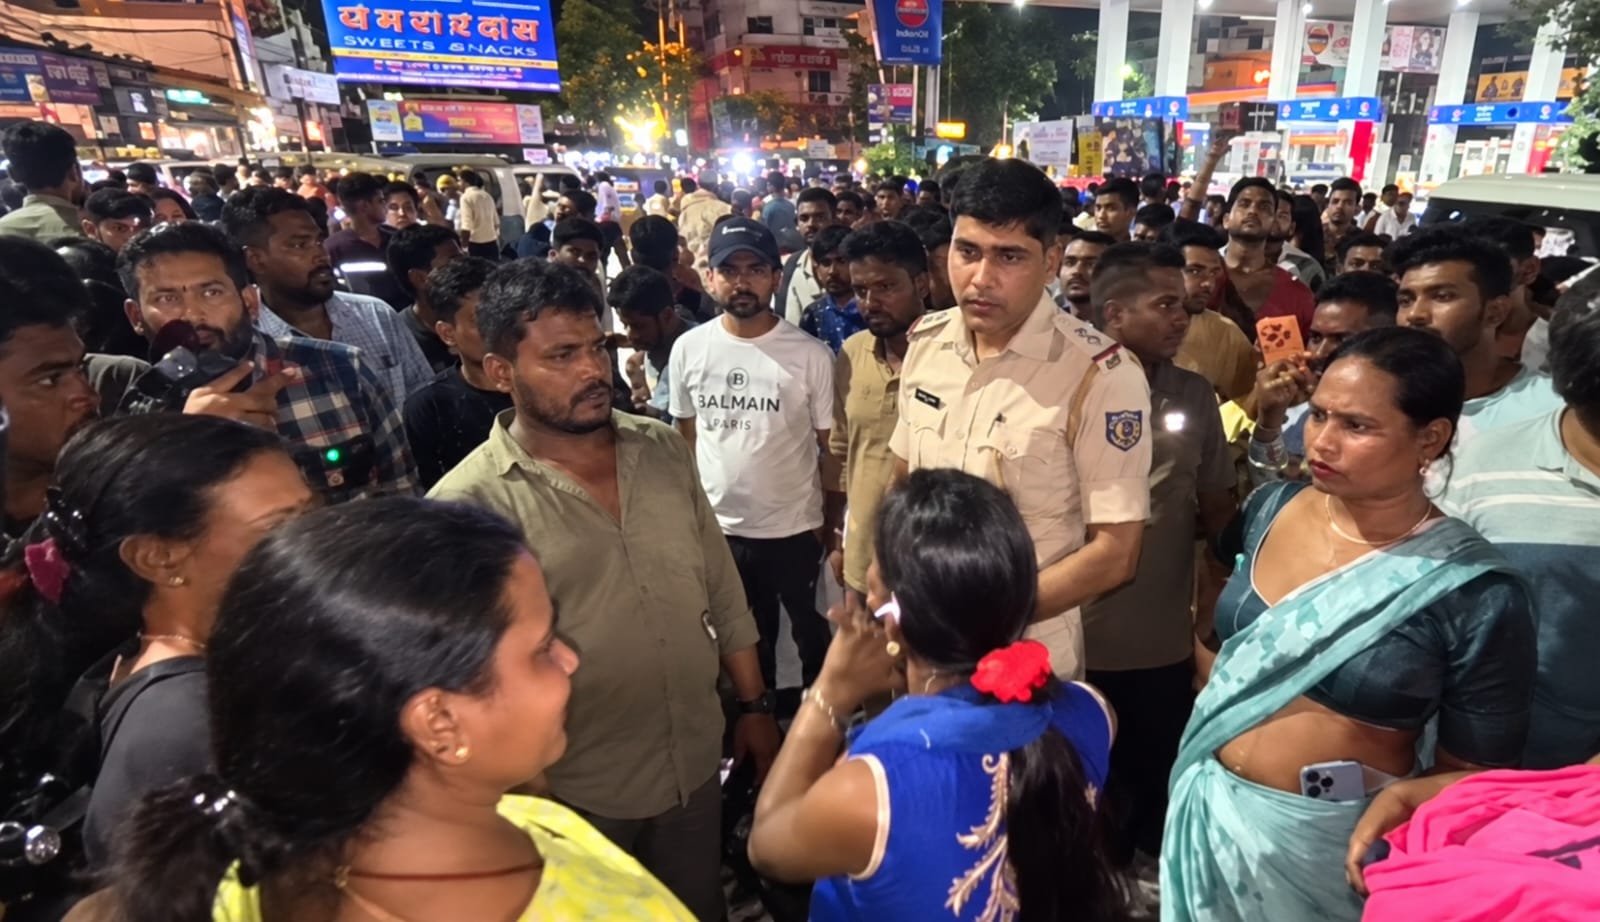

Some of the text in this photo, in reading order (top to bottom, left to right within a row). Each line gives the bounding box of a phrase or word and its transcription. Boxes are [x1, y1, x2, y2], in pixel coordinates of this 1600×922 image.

[343, 35, 436, 51] SWEETS
[732, 373, 745, 386] B
[698, 394, 781, 412] BALMAIN
[713, 418, 752, 431] PARIS
